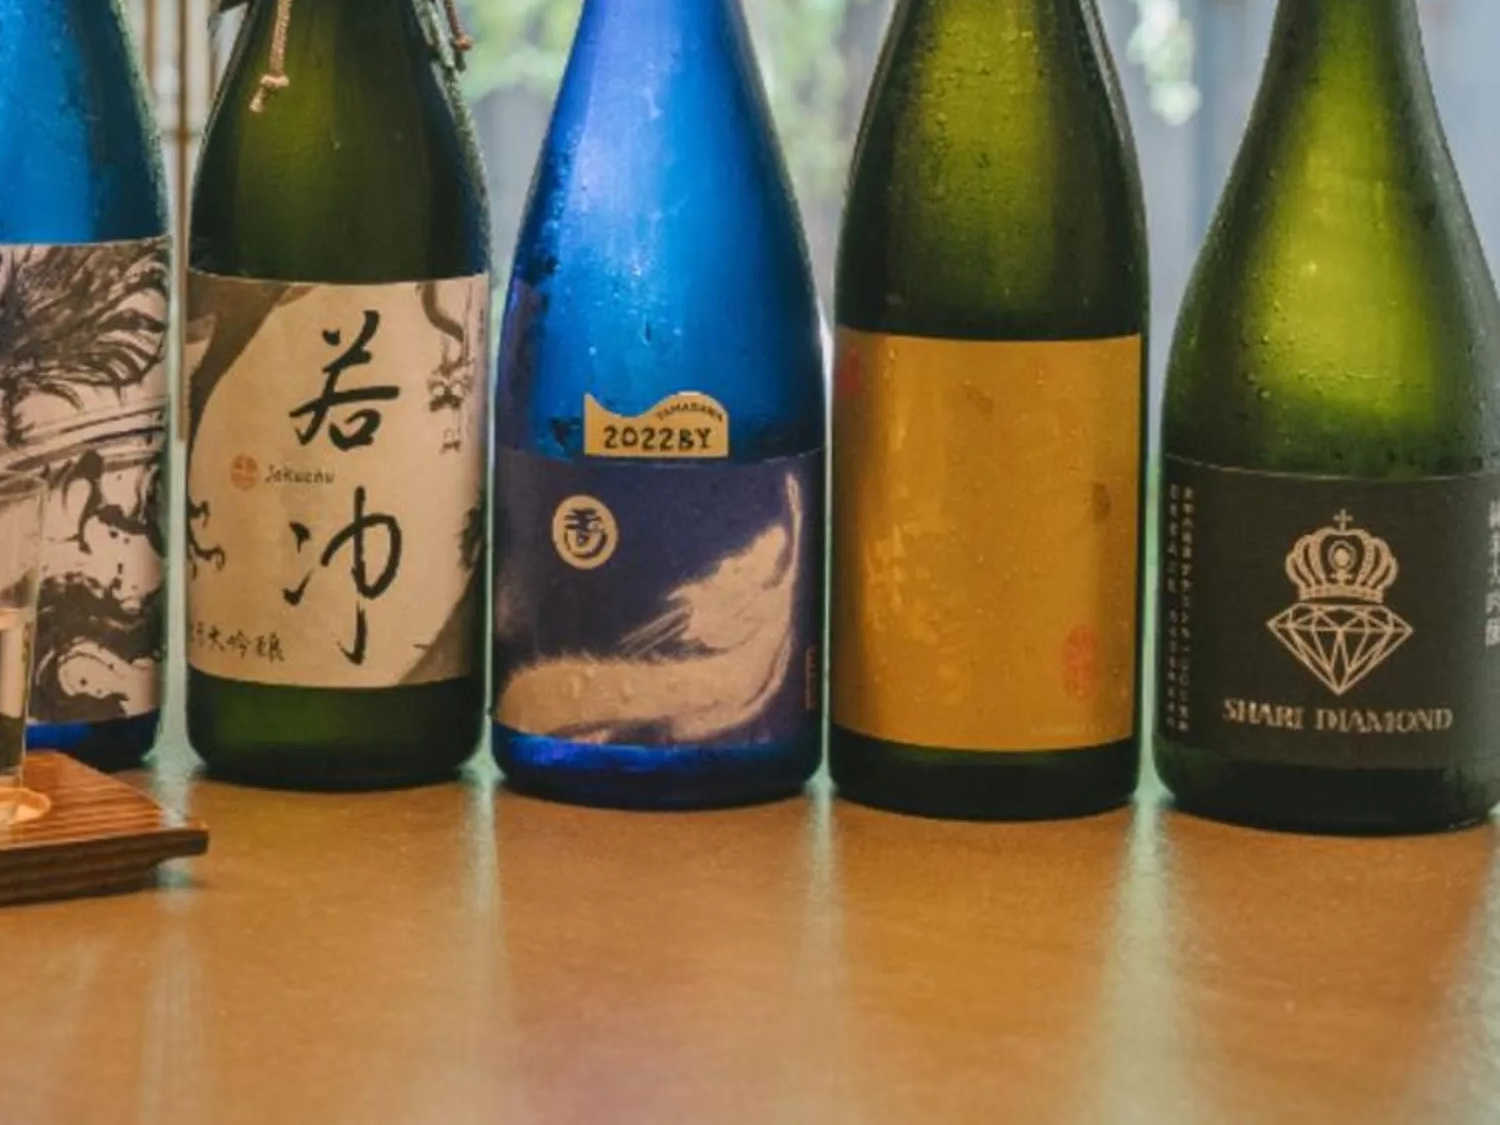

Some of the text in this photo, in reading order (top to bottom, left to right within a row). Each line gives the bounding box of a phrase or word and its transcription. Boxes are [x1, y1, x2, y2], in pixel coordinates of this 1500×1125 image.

[603, 424, 712, 452] 2022BY
[1221, 697, 1454, 734] SHARI DIAMOND
